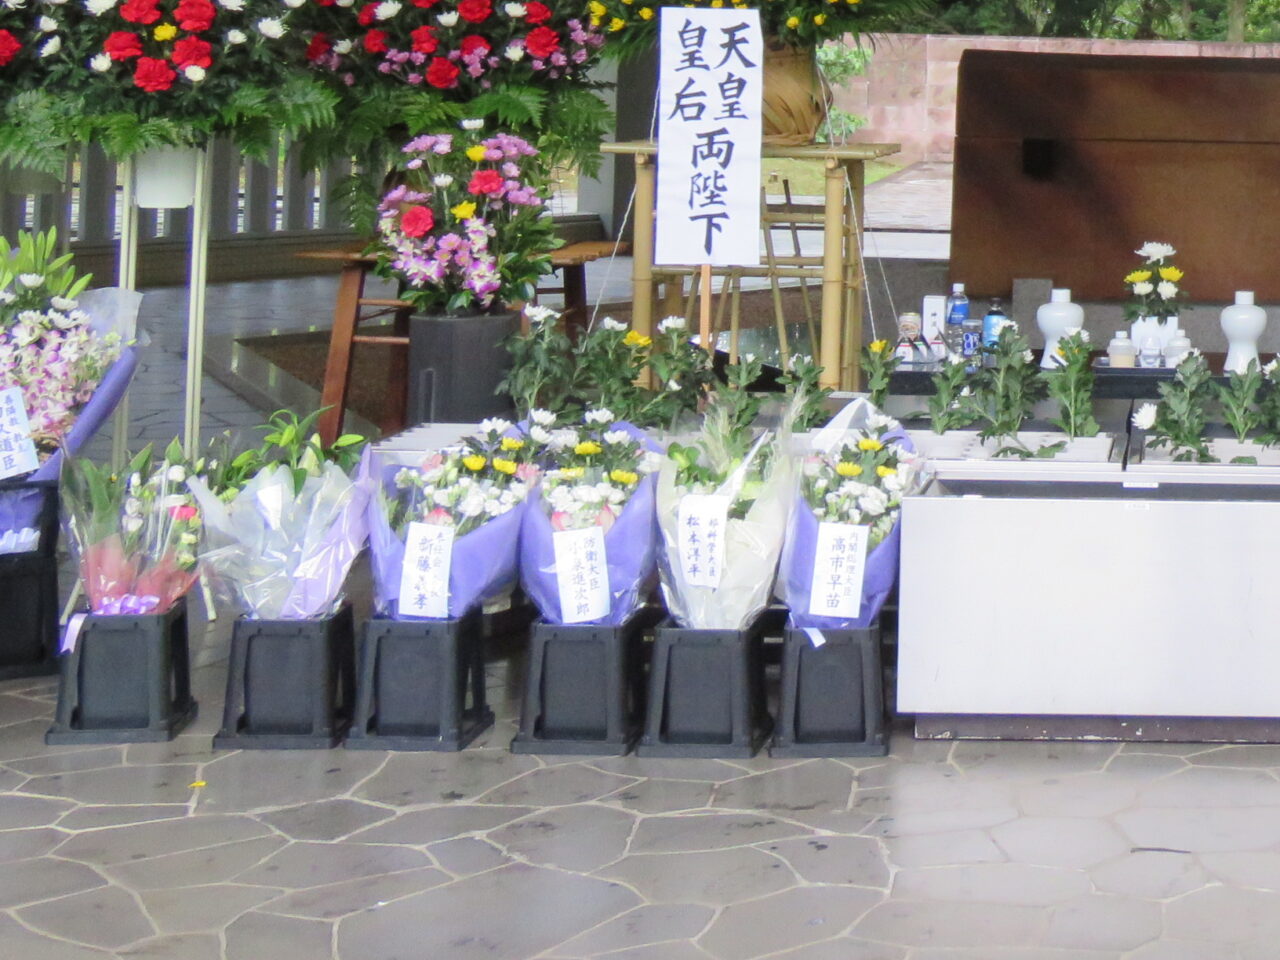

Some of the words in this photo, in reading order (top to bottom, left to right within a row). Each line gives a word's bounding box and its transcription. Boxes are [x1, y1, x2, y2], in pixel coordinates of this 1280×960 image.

[667, 18, 710, 122] 皇后
[713, 21, 758, 121] 天皇
[687, 127, 735, 256] 両陛下
[583, 536, 600, 591] 防衛大臣
[826, 536, 846, 608] 高市早苗
[843, 532, 858, 597] 内閣総理大臣
